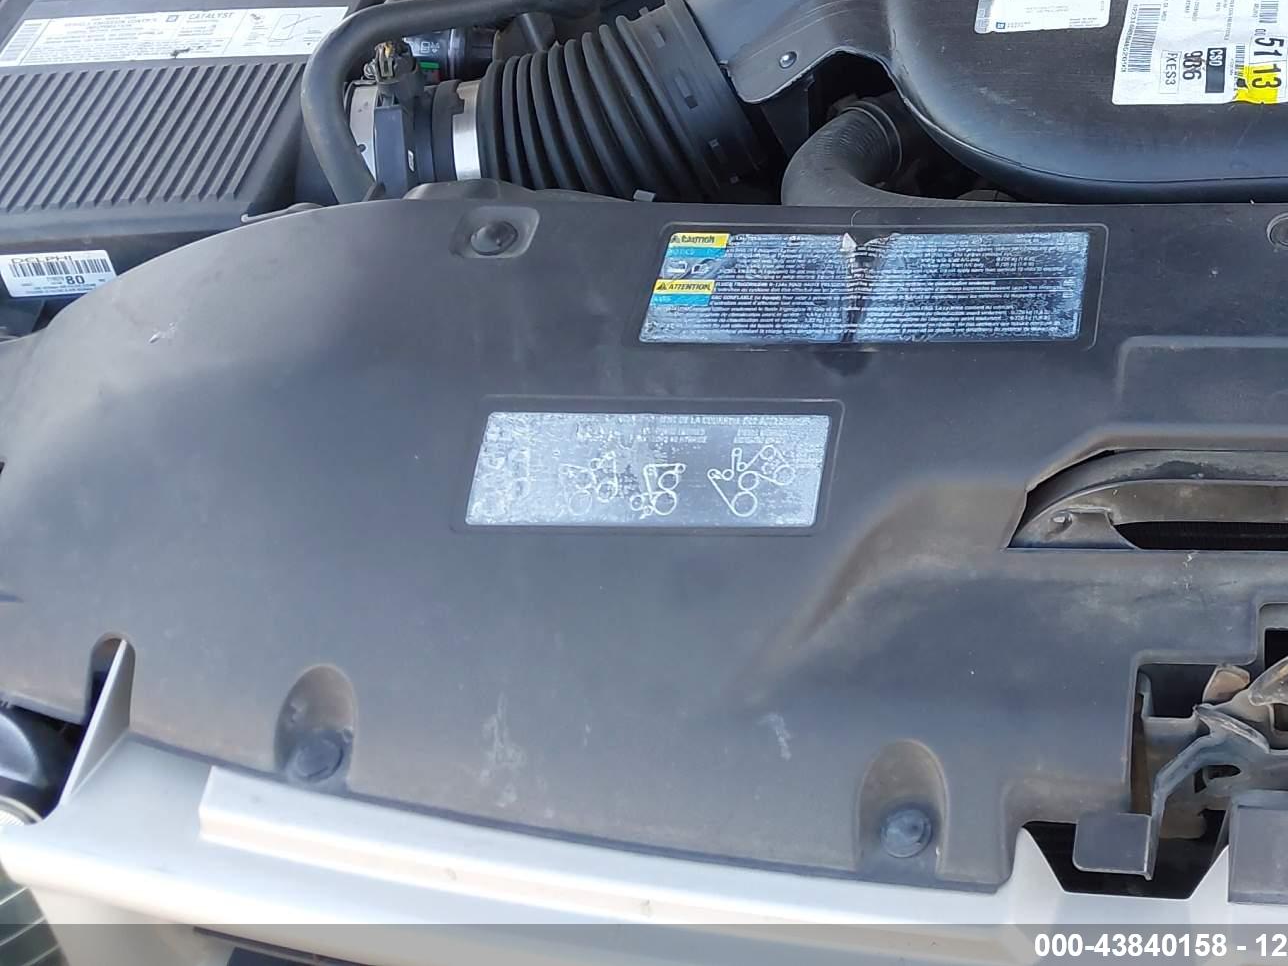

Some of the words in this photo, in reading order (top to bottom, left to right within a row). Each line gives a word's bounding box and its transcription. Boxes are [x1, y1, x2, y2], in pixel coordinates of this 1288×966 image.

[1253, 37, 1285, 56] 51
[1251, 63, 1282, 89] 13
[65, 275, 85, 285] 80
[668, 283, 711, 291] ATTENTION
